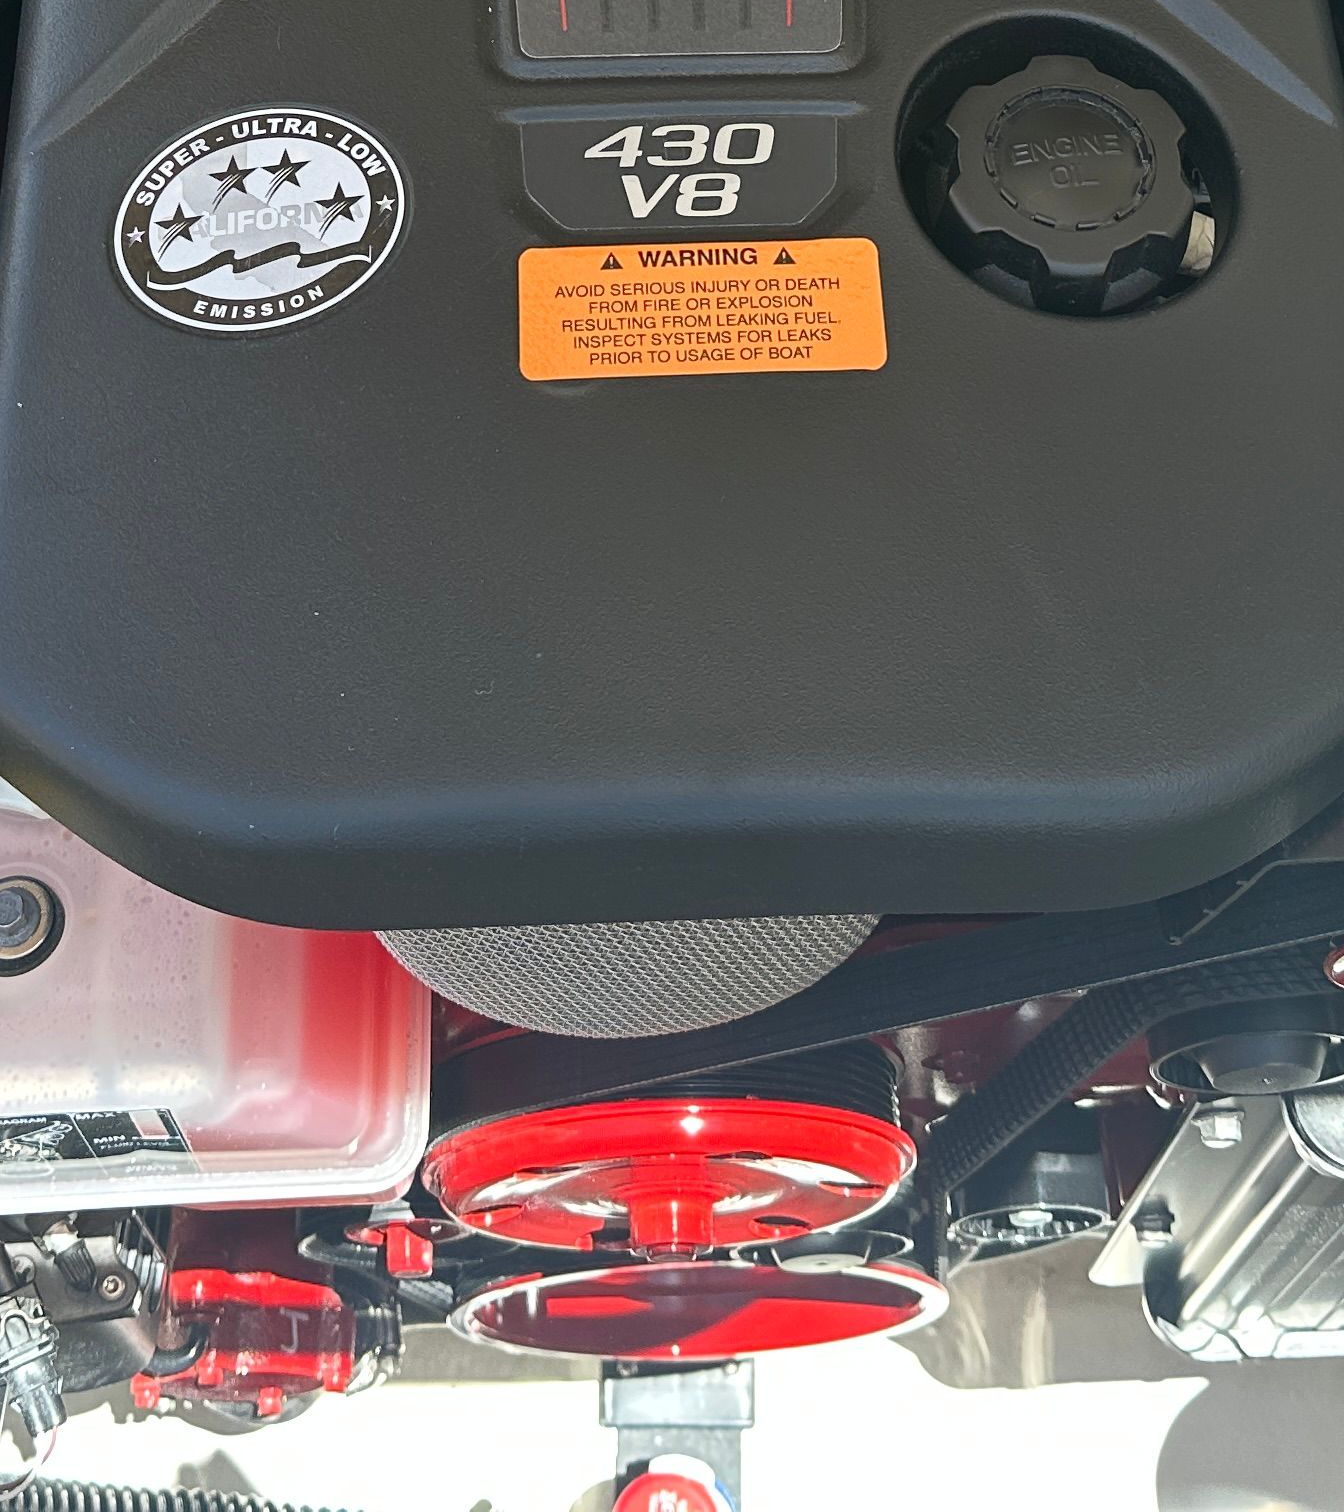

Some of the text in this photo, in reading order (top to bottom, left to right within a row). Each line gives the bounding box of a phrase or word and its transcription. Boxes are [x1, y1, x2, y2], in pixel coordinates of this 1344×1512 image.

[583, 121, 776, 168] 430
[1012, 134, 1123, 166] ENGINE
[136, 138, 210, 207] SUPER
[231, 117, 317, 139] ULTRA
[337, 133, 386, 177] LOW
[1050, 164, 1102, 188] OIL
[620, 171, 740, 221] V8
[638, 247, 757, 268] WARNING
[555, 276, 839, 299] AVOID SERIOUS INJURY OR DEATH
[193, 284, 324, 319] EMISSION
[589, 294, 812, 314] FROM FIRE OR EXPLOSION
[561, 317, 656, 332] RESULTING
[662, 315, 710, 329] FROM
[716, 312, 788, 327] LEAKING
[573, 327, 831, 349] INSPECT SYSTEMS FOR LEAKS
[589, 345, 812, 365] PRIOR TO USAGE OF BOAT
